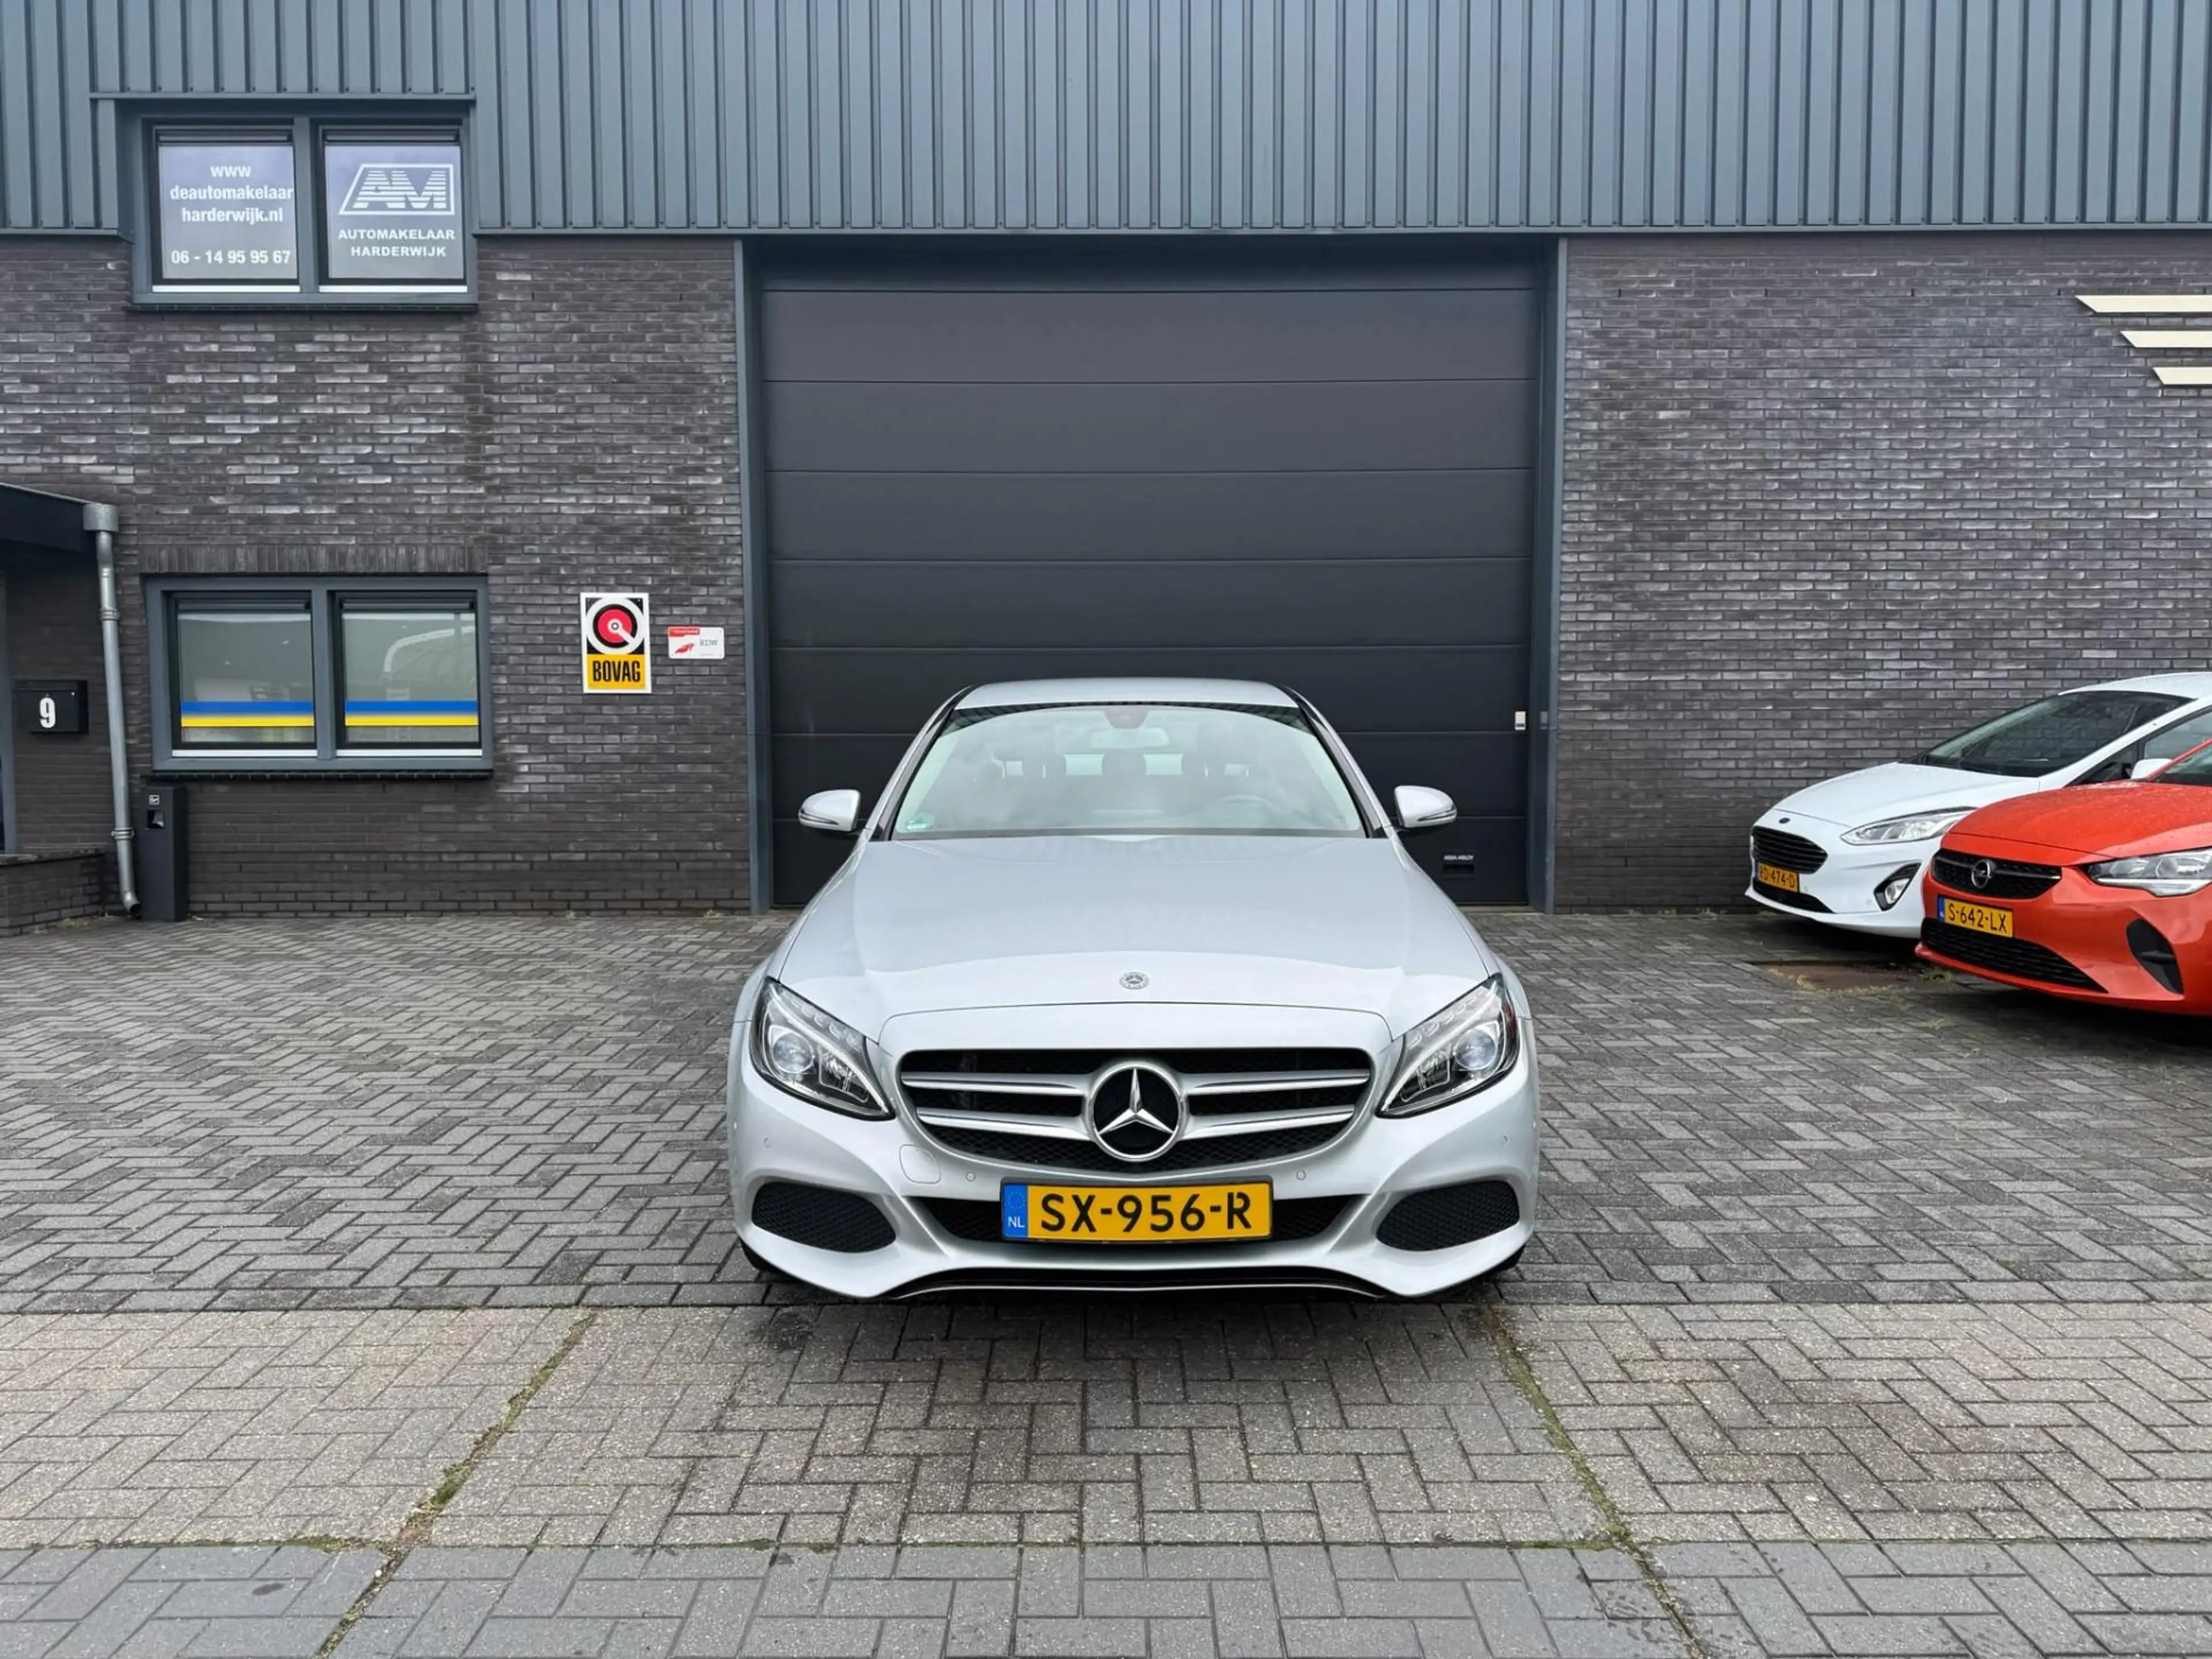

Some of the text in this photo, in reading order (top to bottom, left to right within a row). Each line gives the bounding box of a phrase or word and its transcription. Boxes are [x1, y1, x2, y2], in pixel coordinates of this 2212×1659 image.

[210, 165, 251, 177] www
[170, 184, 294, 200] deautomakelaar
[181, 207, 283, 226] harderwijk.nl
[338, 229, 456, 240] AUTOMAKELAAR
[171, 250, 190, 264] 06
[205, 250, 224, 264] 14
[227, 250, 246, 264] 95
[249, 250, 268, 264] 95
[272, 250, 291, 264] 67
[351, 246, 446, 257] HARDERWIJK
[593, 660, 640, 682] BOVAG
[39, 697, 56, 728] 9
[1948, 903, 2007, 933] S-642-LX
[1040, 1191, 1251, 1232] SX-956-R
[1008, 1217, 1024, 1228] NL
